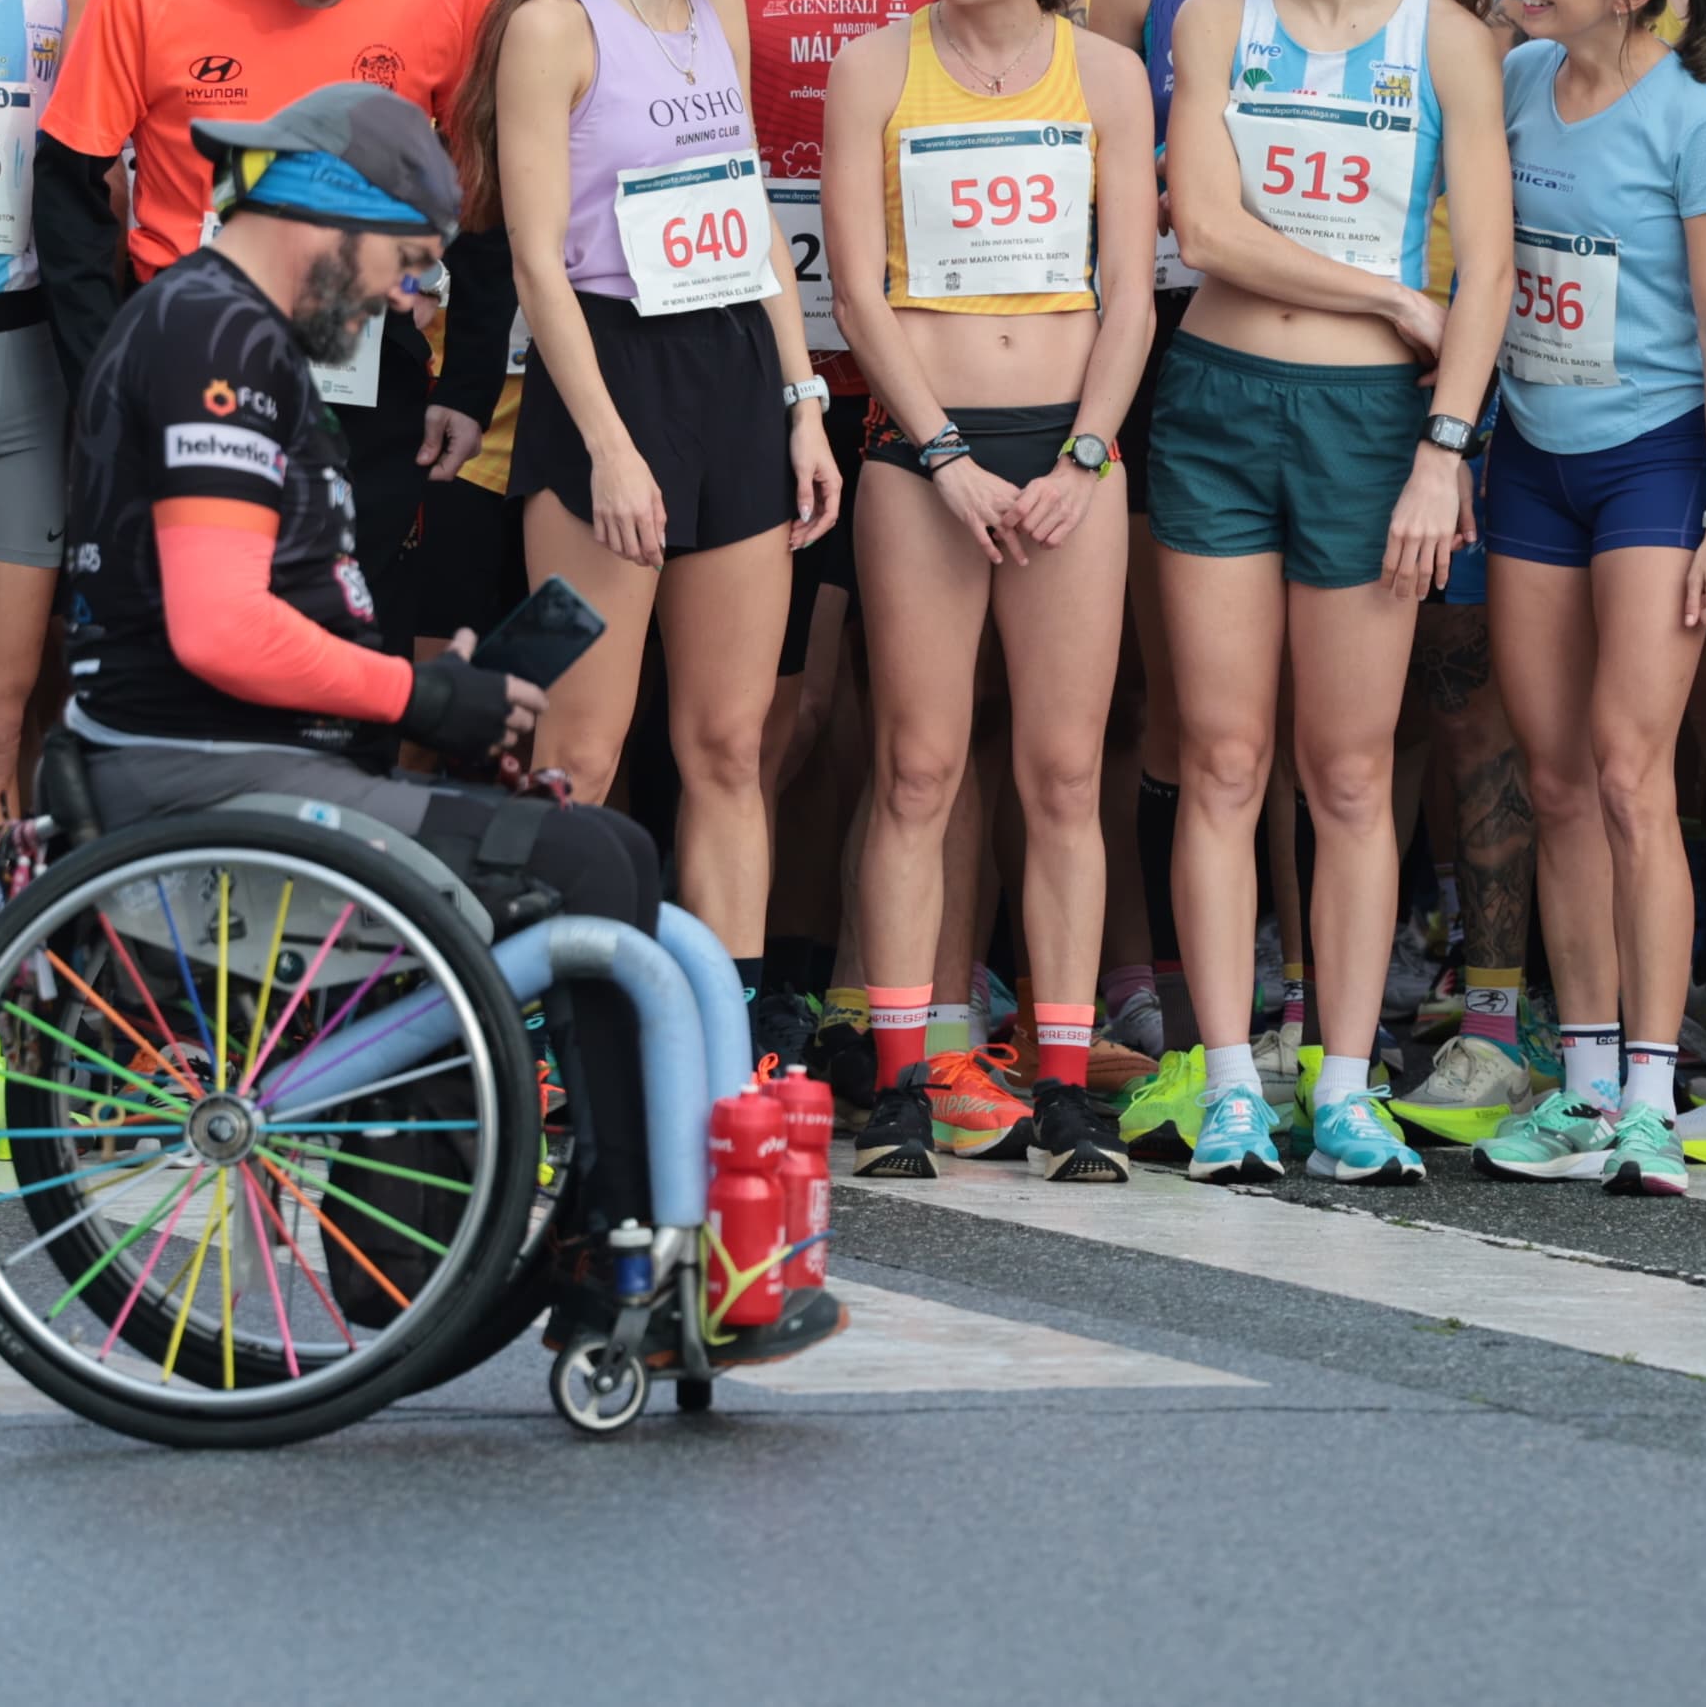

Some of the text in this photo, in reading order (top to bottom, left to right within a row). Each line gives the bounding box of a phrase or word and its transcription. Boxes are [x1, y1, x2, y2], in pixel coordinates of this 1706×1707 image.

[186, 88, 248, 99] HYUNDAI
[649, 86, 744, 128] OYSHO
[1252, 106, 1340, 120] www.deporte.malaga.eu
[675, 125, 740, 147] RUNNING CLUB
[925, 135, 1016, 149] www.deporte.malaga.eu
[1262, 145, 1372, 205] 513
[951, 173, 1058, 229] 593
[1269, 206, 1296, 218] CLAUDIA
[663, 208, 748, 269] 640
[1313, 228, 1335, 238] PEÑA
[1336, 230, 1346, 239] EL
[1348, 231, 1381, 242] BASTÓN
[951, 257, 968, 265] MINI
[969, 253, 1010, 264] MARATÓN
[1012, 251, 1033, 262] PEÑA
[1035, 253, 1044, 261] EL
[686, 292, 717, 304] MARATÓN
[735, 288, 743, 296] EL
[1515, 268, 1584, 331] 556
[1561, 357, 1569, 366] EL
[1571, 357, 1601, 368] BASTÓN
